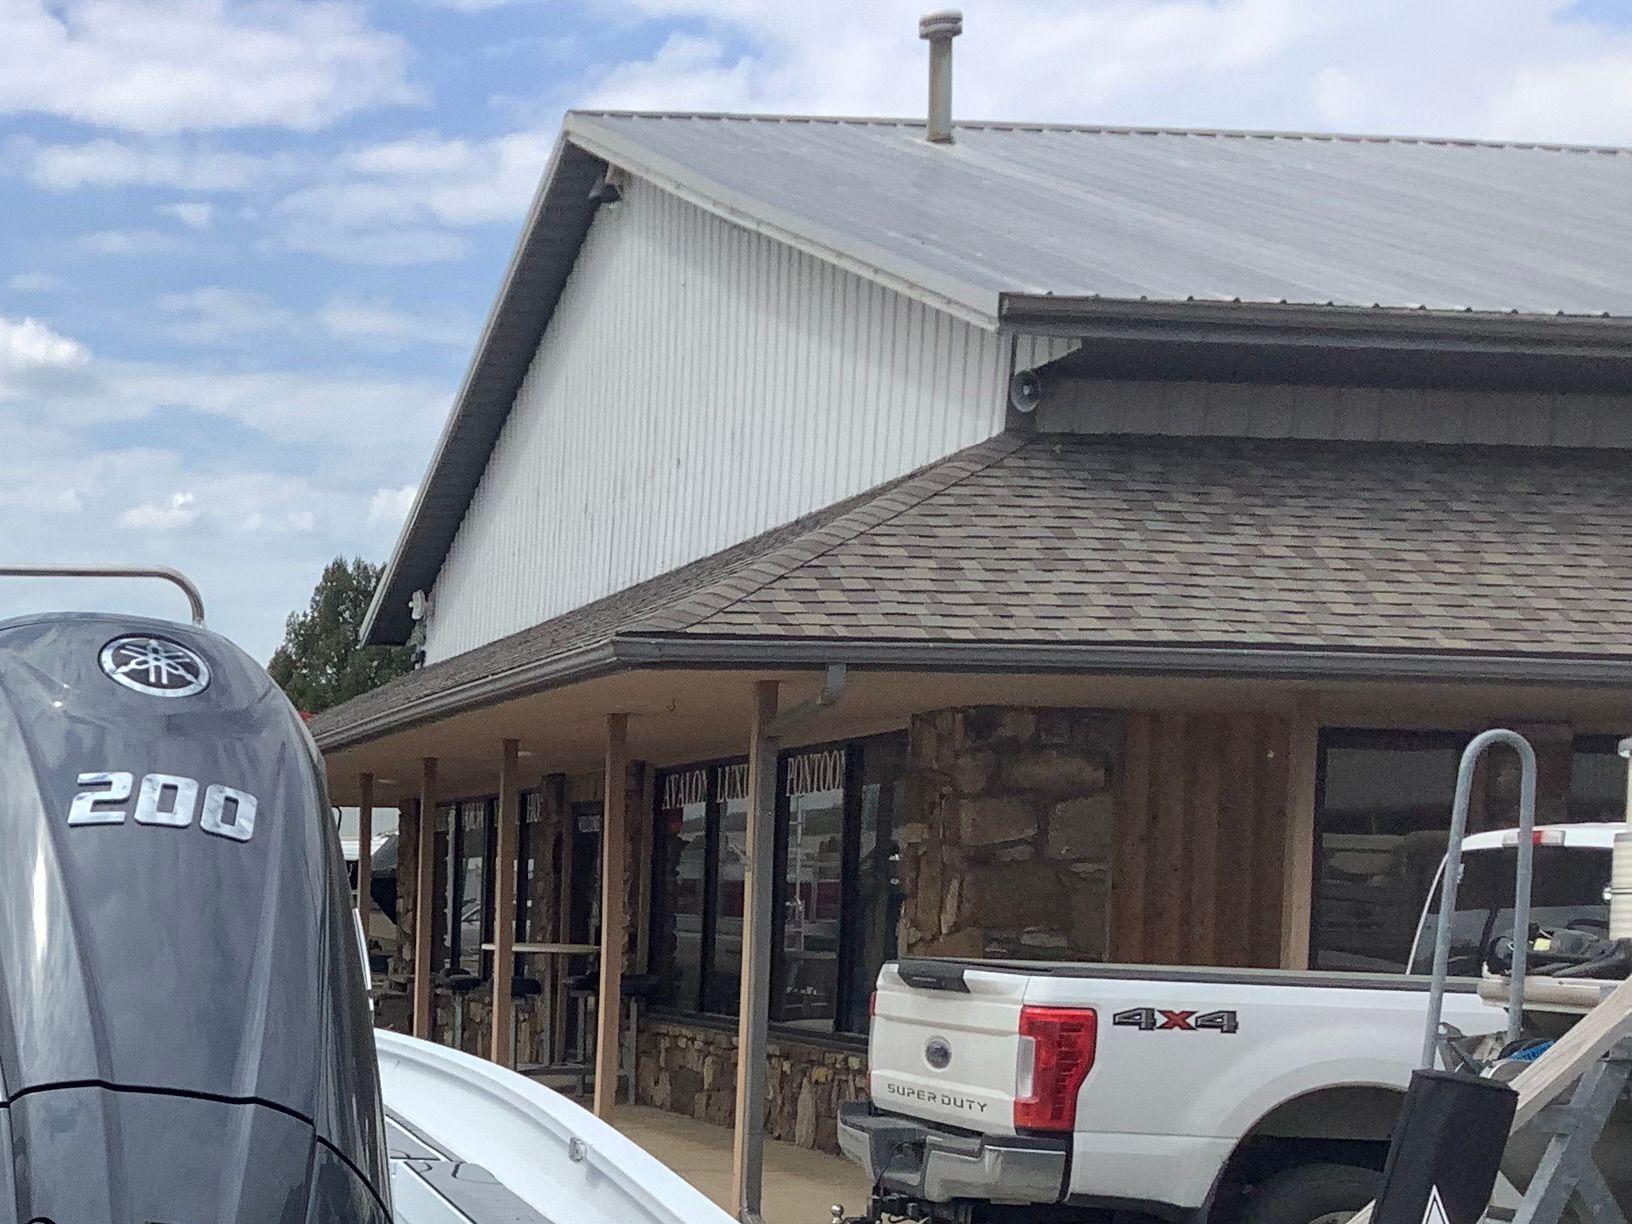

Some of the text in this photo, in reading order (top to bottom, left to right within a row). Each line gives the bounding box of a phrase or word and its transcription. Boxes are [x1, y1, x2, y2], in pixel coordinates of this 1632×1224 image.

[68, 771, 258, 843] 200
[887, 1083, 988, 1113] SUPER DUTY
